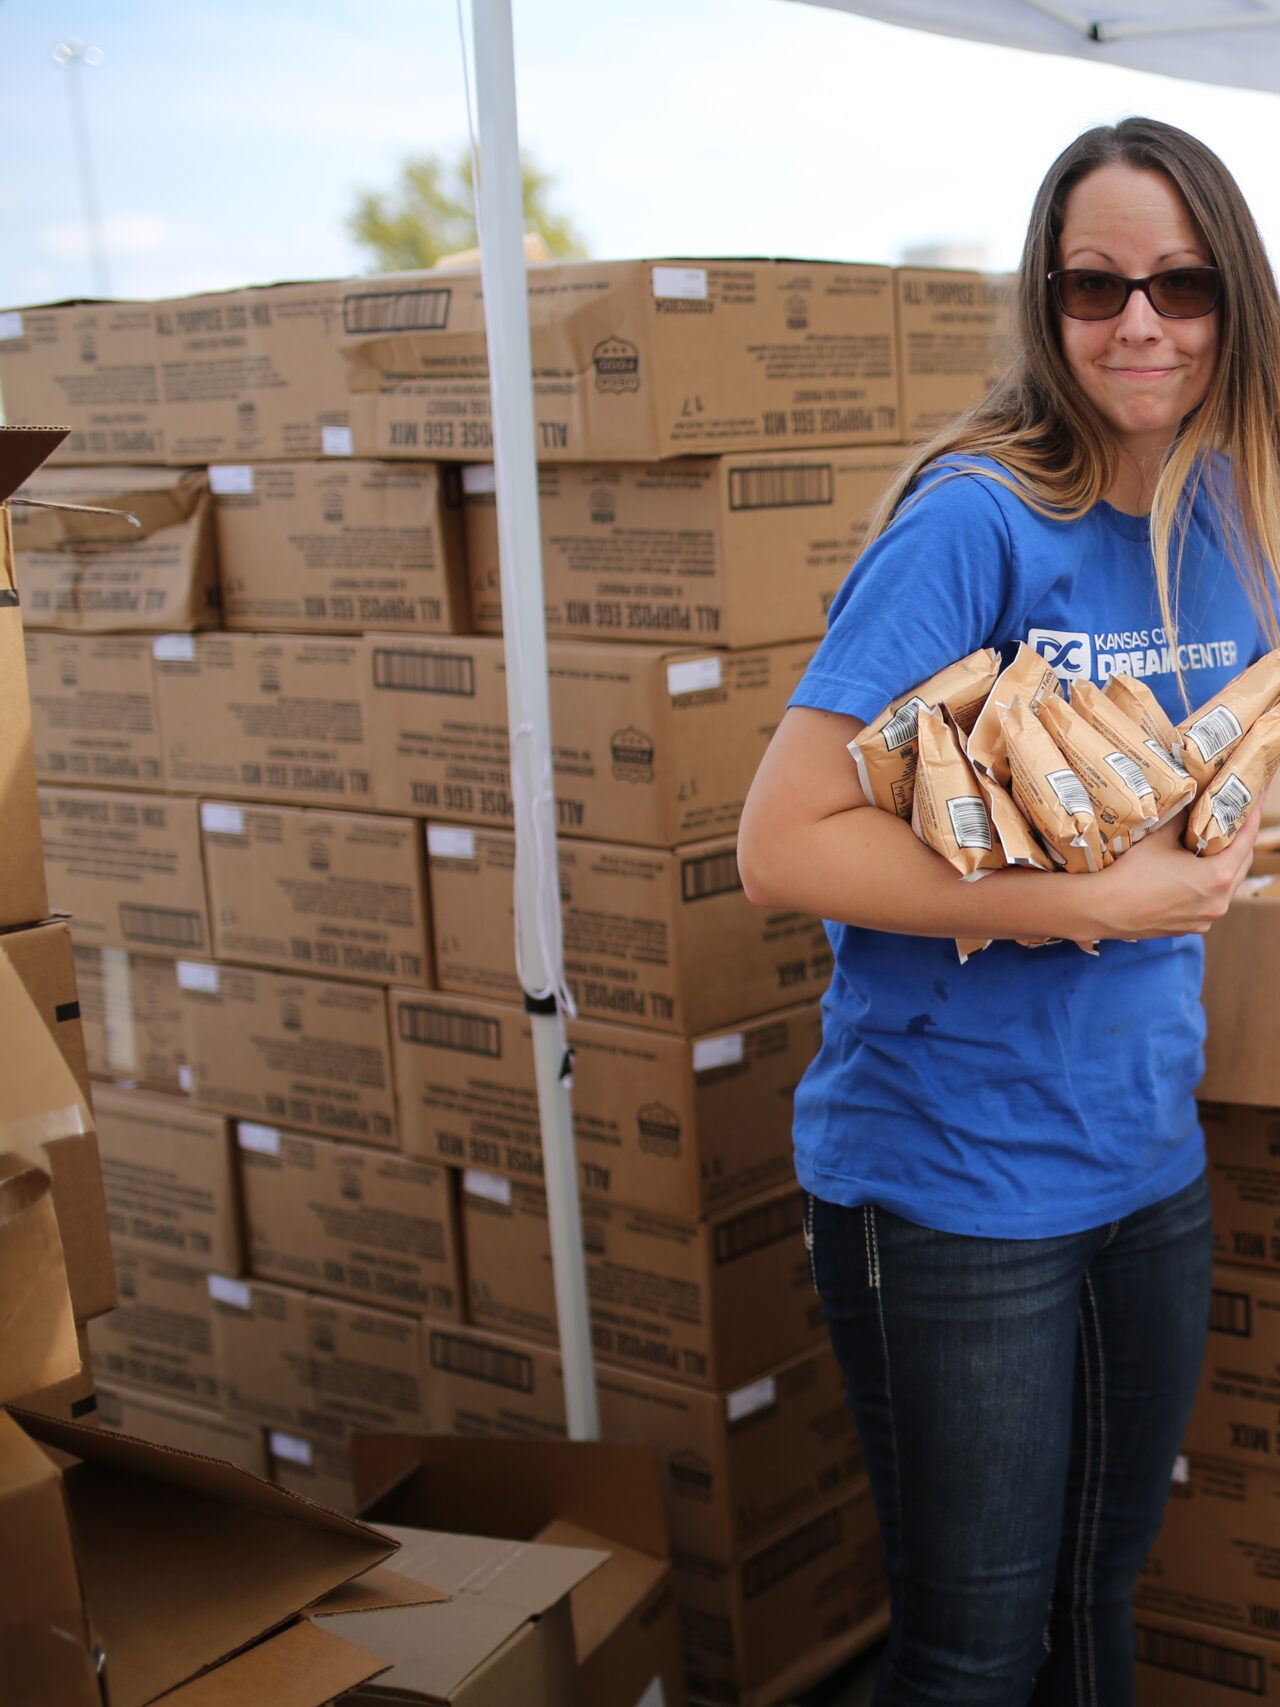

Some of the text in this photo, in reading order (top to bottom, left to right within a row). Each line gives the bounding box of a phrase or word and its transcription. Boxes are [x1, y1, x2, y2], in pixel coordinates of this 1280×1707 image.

[388, 422, 567, 448] ALL EGG MIX
[762, 407, 896, 437] ALL PURPOSE EGG MIX
[564, 601, 720, 632] ALL PURPOSE EGG MIX
[1095, 631, 1149, 650] KANSAS
[1230, 1424, 1270, 1453] MIX
